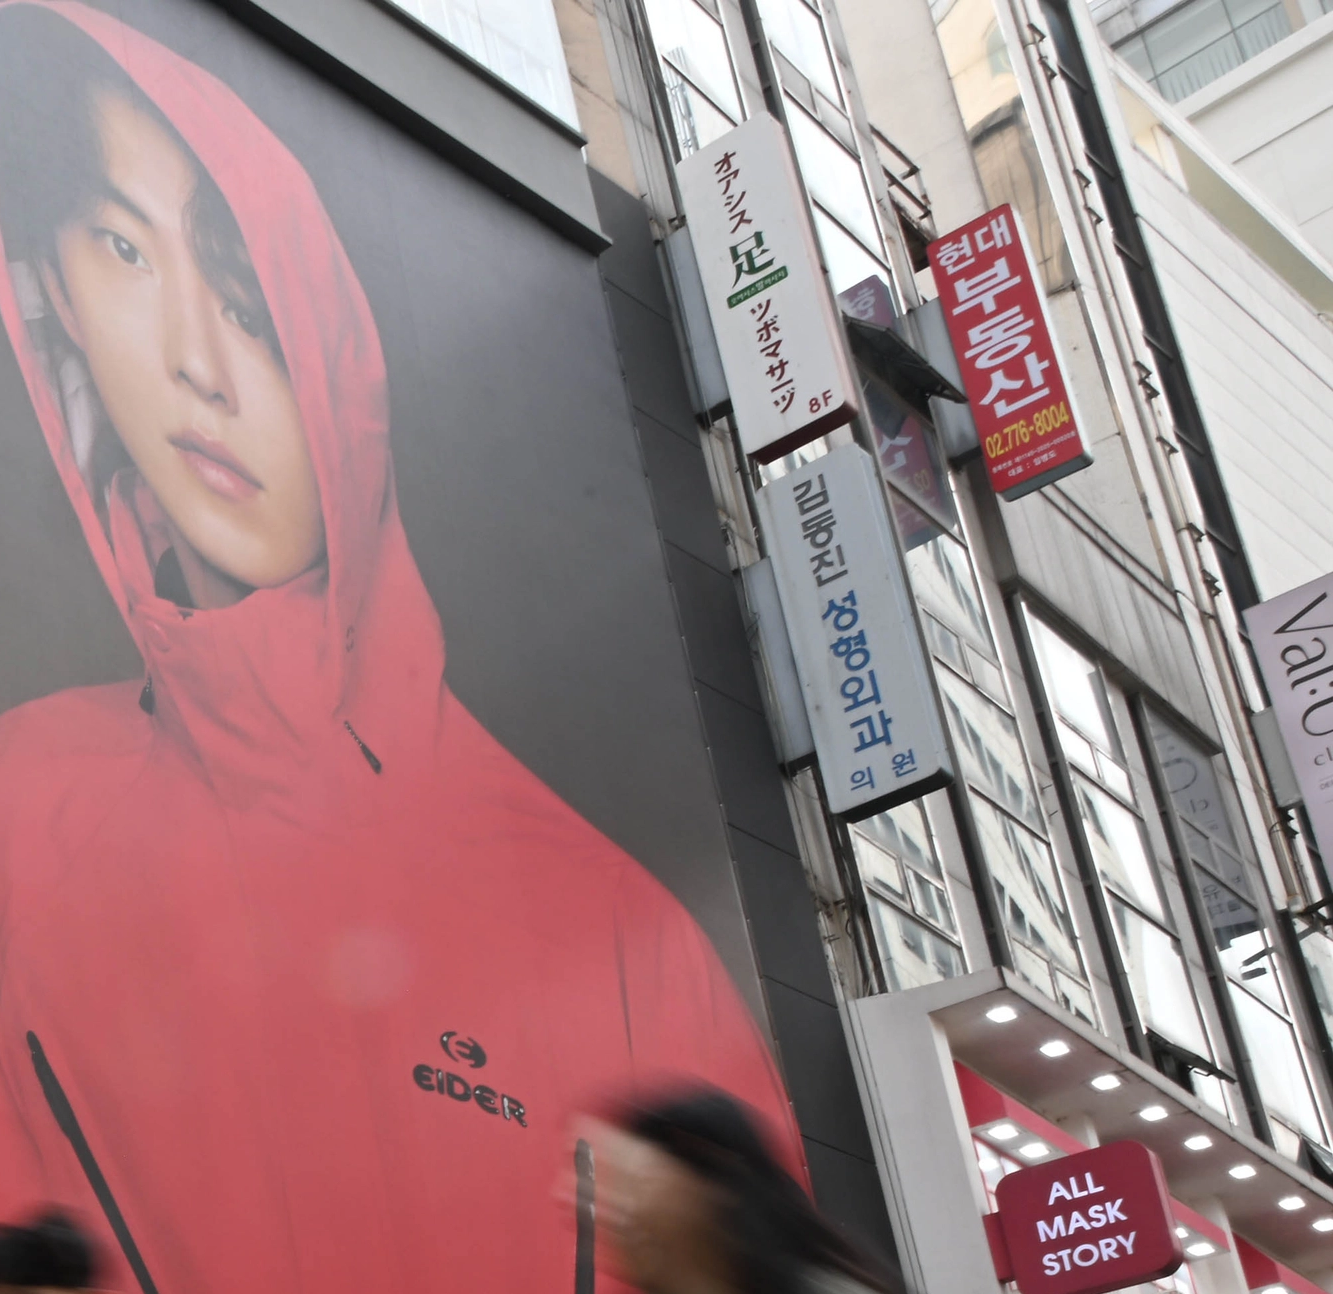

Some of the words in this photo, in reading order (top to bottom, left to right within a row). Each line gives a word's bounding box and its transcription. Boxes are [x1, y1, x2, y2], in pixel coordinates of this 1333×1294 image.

[714, 151, 754, 234] オアシス
[728, 230, 777, 290] 足
[936, 214, 1013, 275] 현대
[951, 256, 1051, 419] 부동산
[808, 389, 834, 414] 8F
[984, 401, 1070, 459] 02.776-8004
[792, 474, 849, 587] 김동진
[822, 590, 893, 754] 성형외과
[412, 1063, 528, 1128] EIDER
[1047, 1172, 1106, 1207] ALL
[1035, 1197, 1129, 1245] MASK
[1041, 1230, 1137, 1278] STORY
